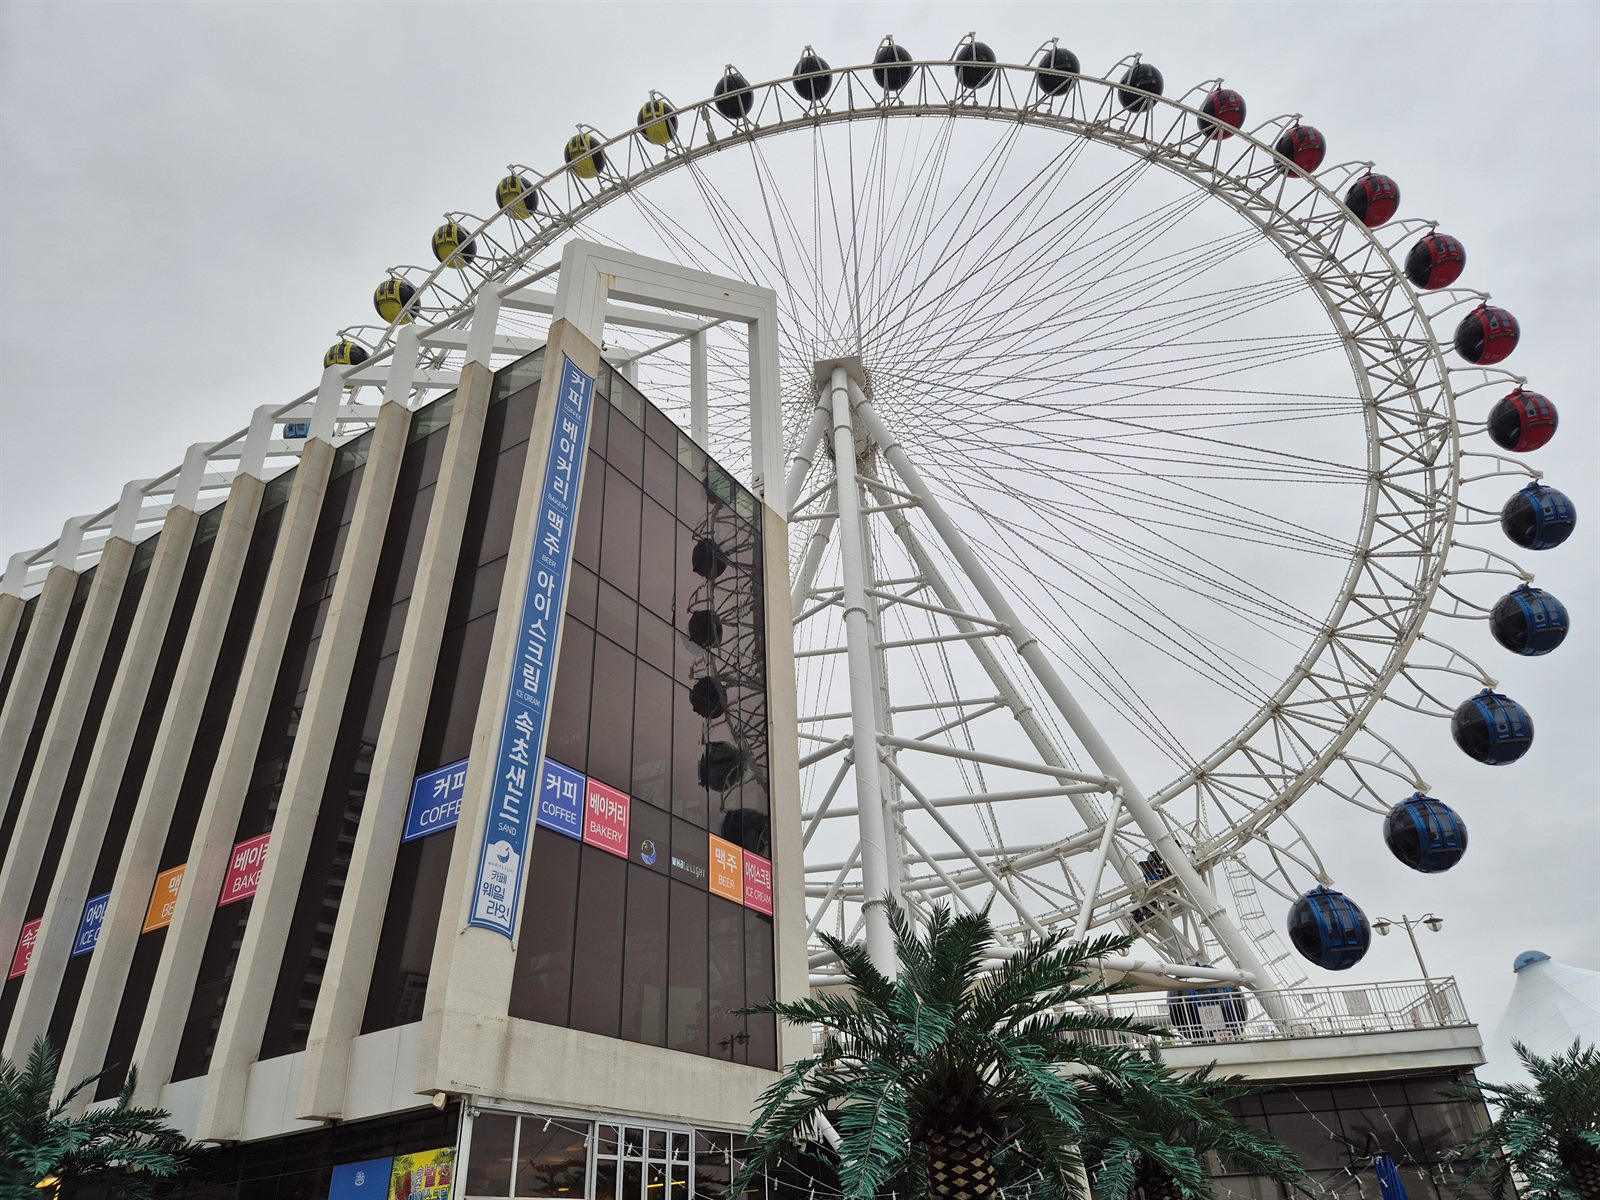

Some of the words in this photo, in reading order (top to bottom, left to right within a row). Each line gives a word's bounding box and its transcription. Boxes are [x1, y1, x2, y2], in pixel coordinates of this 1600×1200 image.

[567, 370, 586, 413] 커피
[563, 403, 583, 421] COFFEE
[553, 416, 579, 502] 베이커리
[547, 493, 569, 512] BAKERY
[542, 509, 564, 557] 맥주
[541, 554, 557, 569] BEER
[522, 570, 556, 694] 아이스크림
[515, 689, 524, 699] ICE
[523, 691, 541, 708] CREAM
[499, 711, 534, 824] 속초샌드
[546, 773, 577, 806] 커피
[542, 801, 577, 825] COFFEE
[590, 792, 626, 827] 베이커리
[498, 822, 517, 837] SAND
[590, 821, 622, 843] BAKERY
[715, 848, 738, 873] 맥주
[491, 870, 508, 885] 카페
[718, 874, 735, 889] BEER
[745, 862, 771, 890] 아이스크림
[482, 882, 505, 902] 웨일
[745, 886, 754, 898] ICE
[754, 889, 772, 904] CREAM
[486, 900, 510, 922] 라잇
[80, 929, 95, 946] ICE
